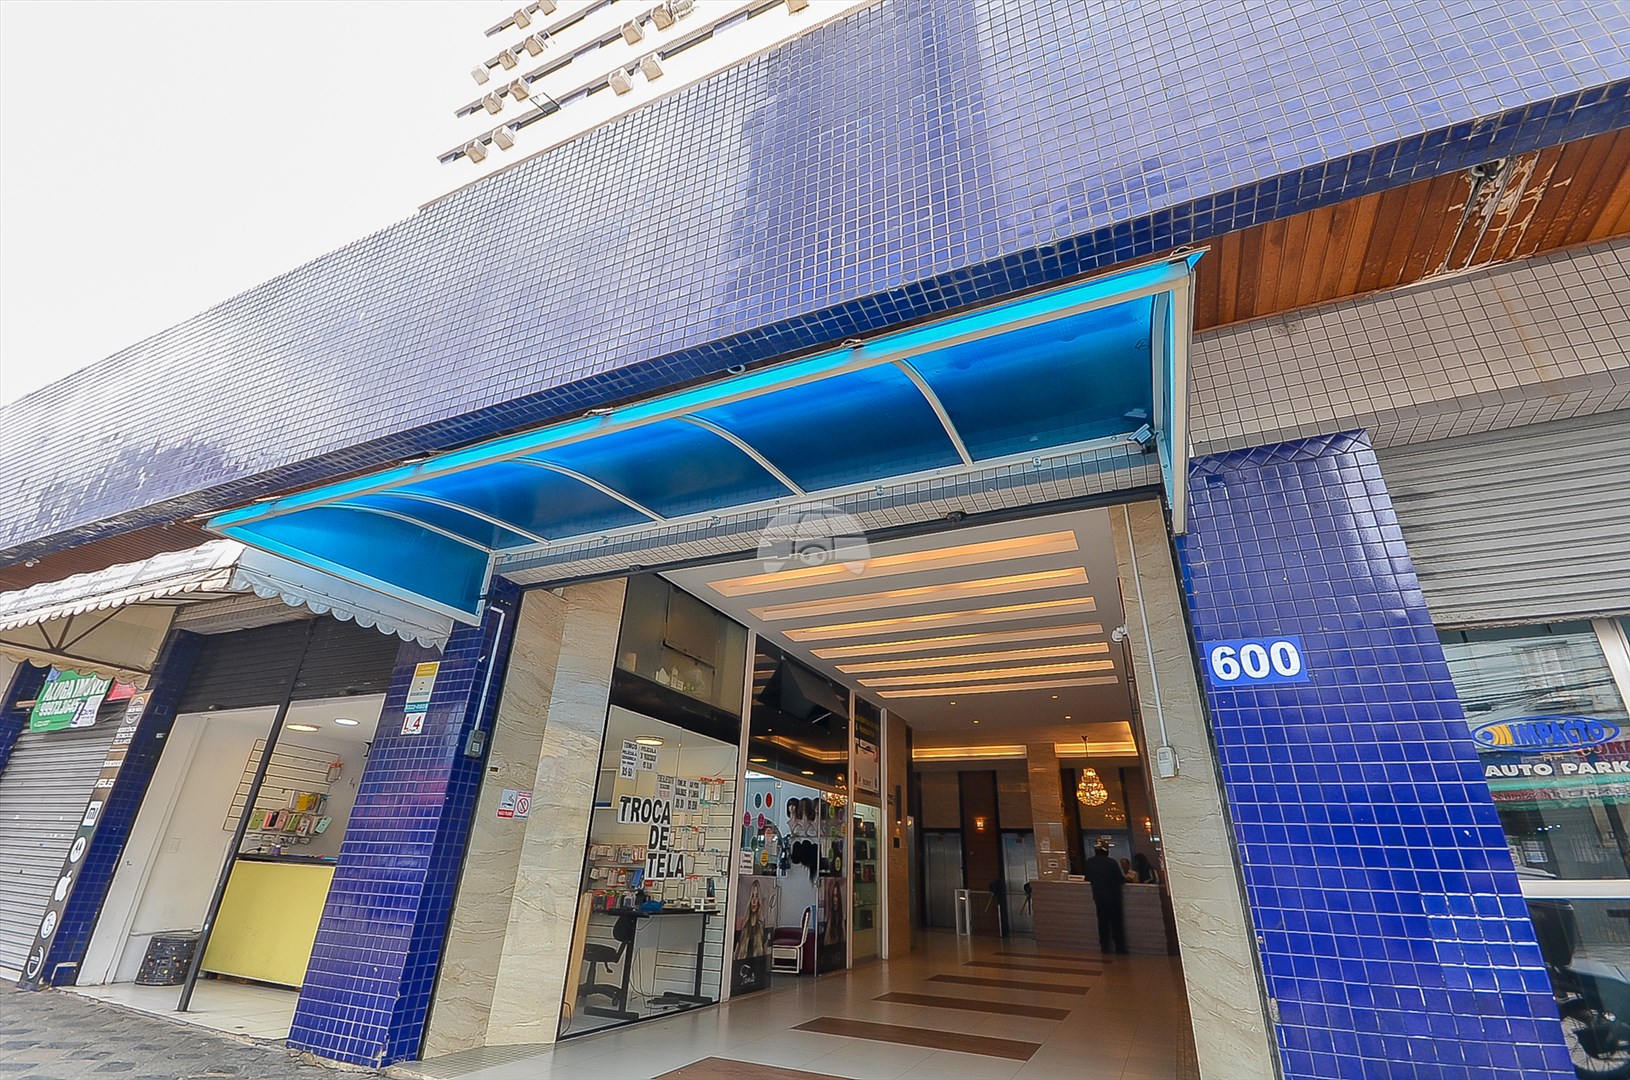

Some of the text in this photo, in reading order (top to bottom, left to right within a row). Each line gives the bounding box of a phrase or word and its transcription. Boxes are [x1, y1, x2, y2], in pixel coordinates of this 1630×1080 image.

[1211, 641, 1301, 681] 600
[42, 680, 75, 701] ALUGA
[1510, 720, 1605, 746] IMPACTO
[1484, 760, 1630, 777] AUTO PARK
[620, 796, 671, 825] TROCA
[648, 825, 670, 851] DE
[647, 853, 684, 878] TELA
